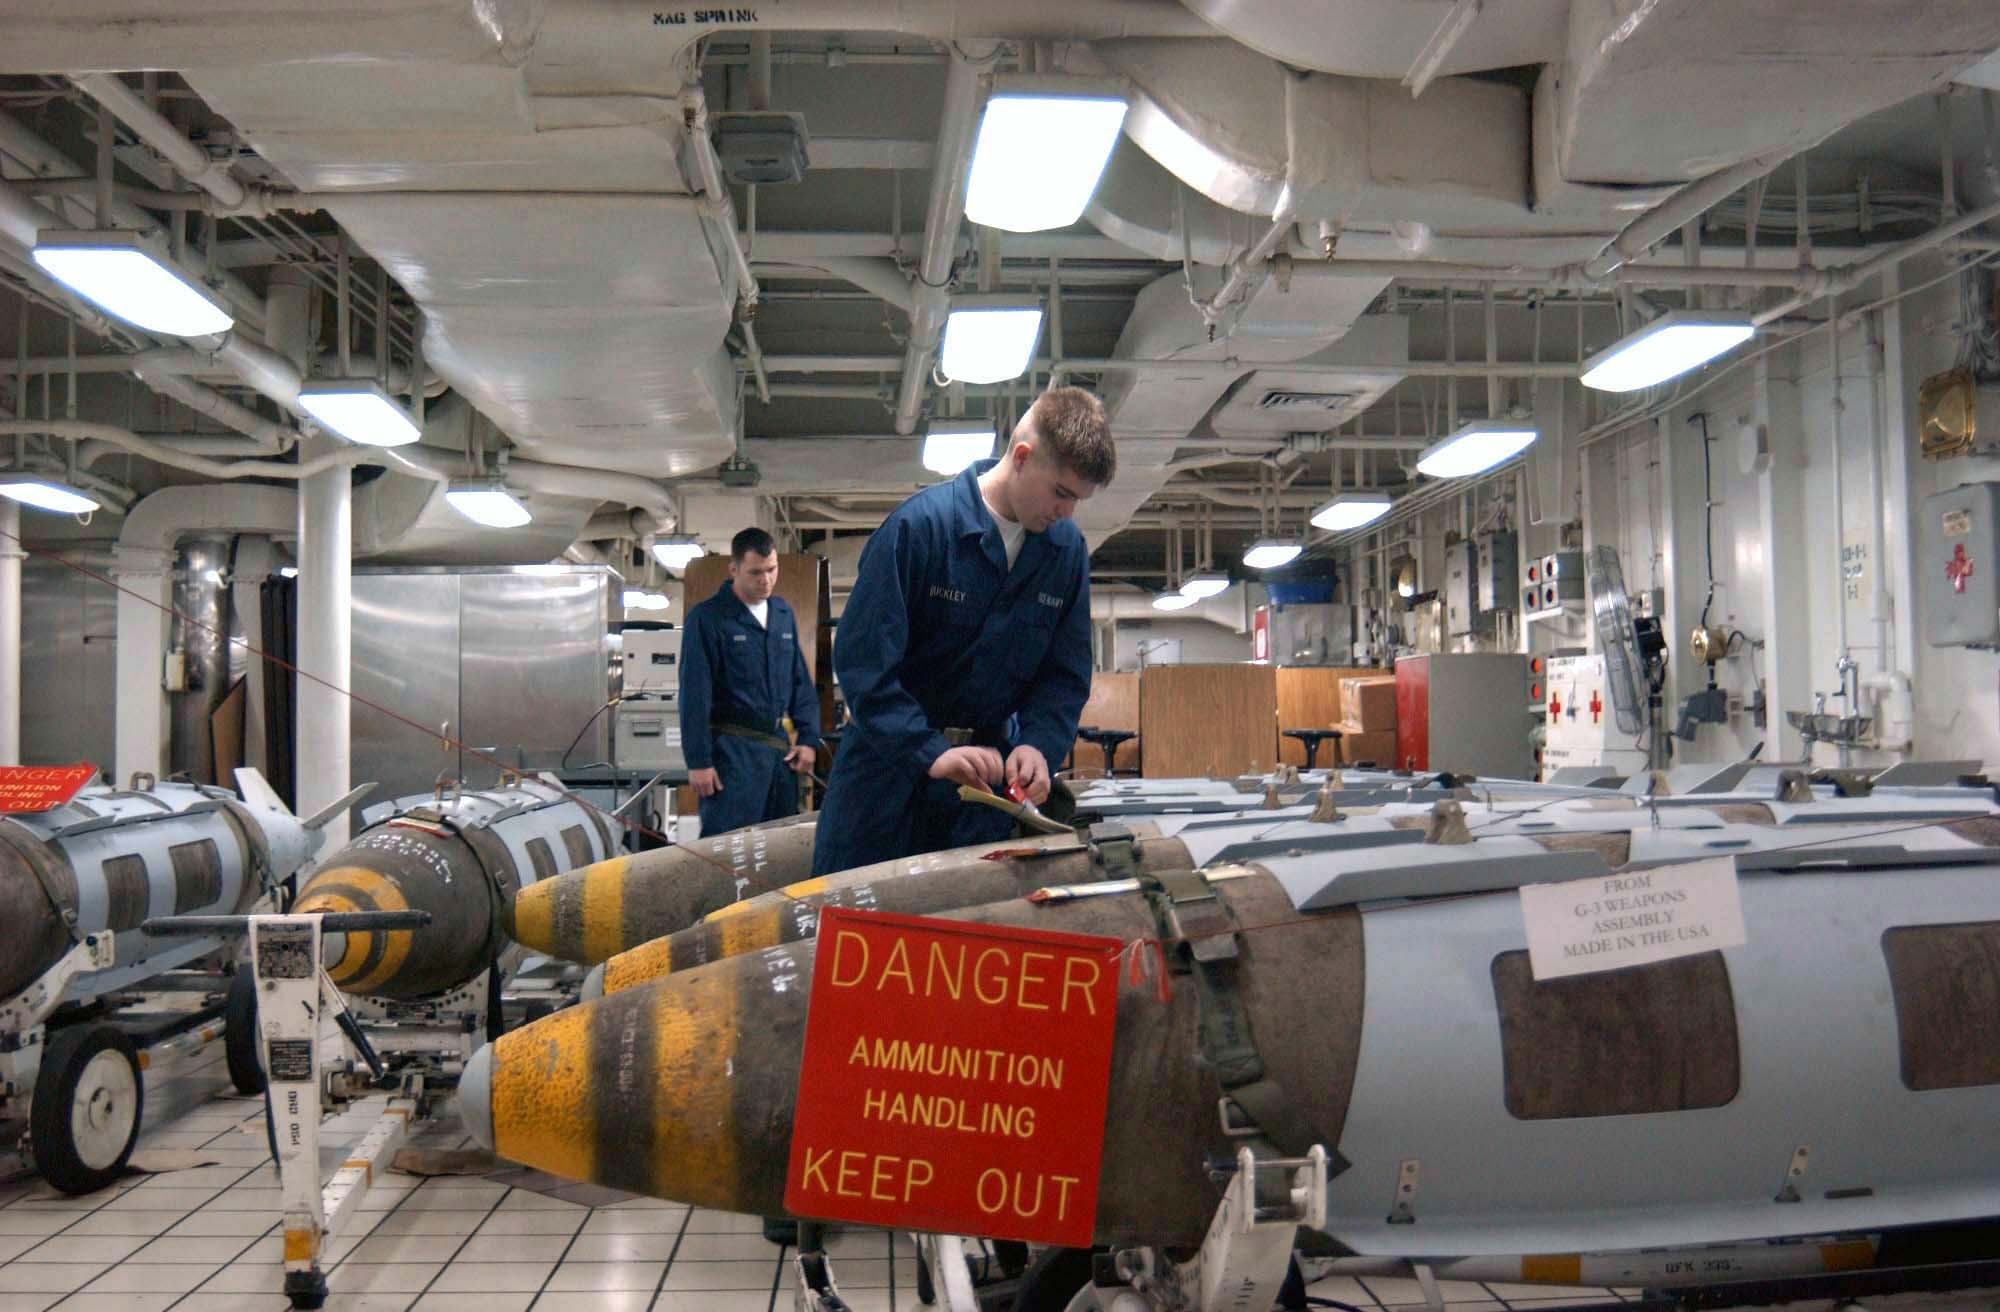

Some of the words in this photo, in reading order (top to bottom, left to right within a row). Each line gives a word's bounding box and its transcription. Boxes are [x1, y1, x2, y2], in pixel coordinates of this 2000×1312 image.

[653, 12, 686, 25] MAG
[1604, 875, 1651, 894] FROM
[1605, 889, 1687, 912] WEAPONS
[1592, 910, 1675, 934] ASSEMBLY
[1563, 939, 1613, 959] MADE
[1616, 934, 1636, 950] IN
[1640, 929, 1674, 946] THE
[1677, 924, 1710, 941] USA
[831, 930, 1101, 1016] DANGER
[848, 1035, 1064, 1089] AMMUNITION
[862, 1088, 1036, 1138] HANDLING
[802, 1146, 934, 1203] KEEP
[976, 1167, 1080, 1221] OUT
